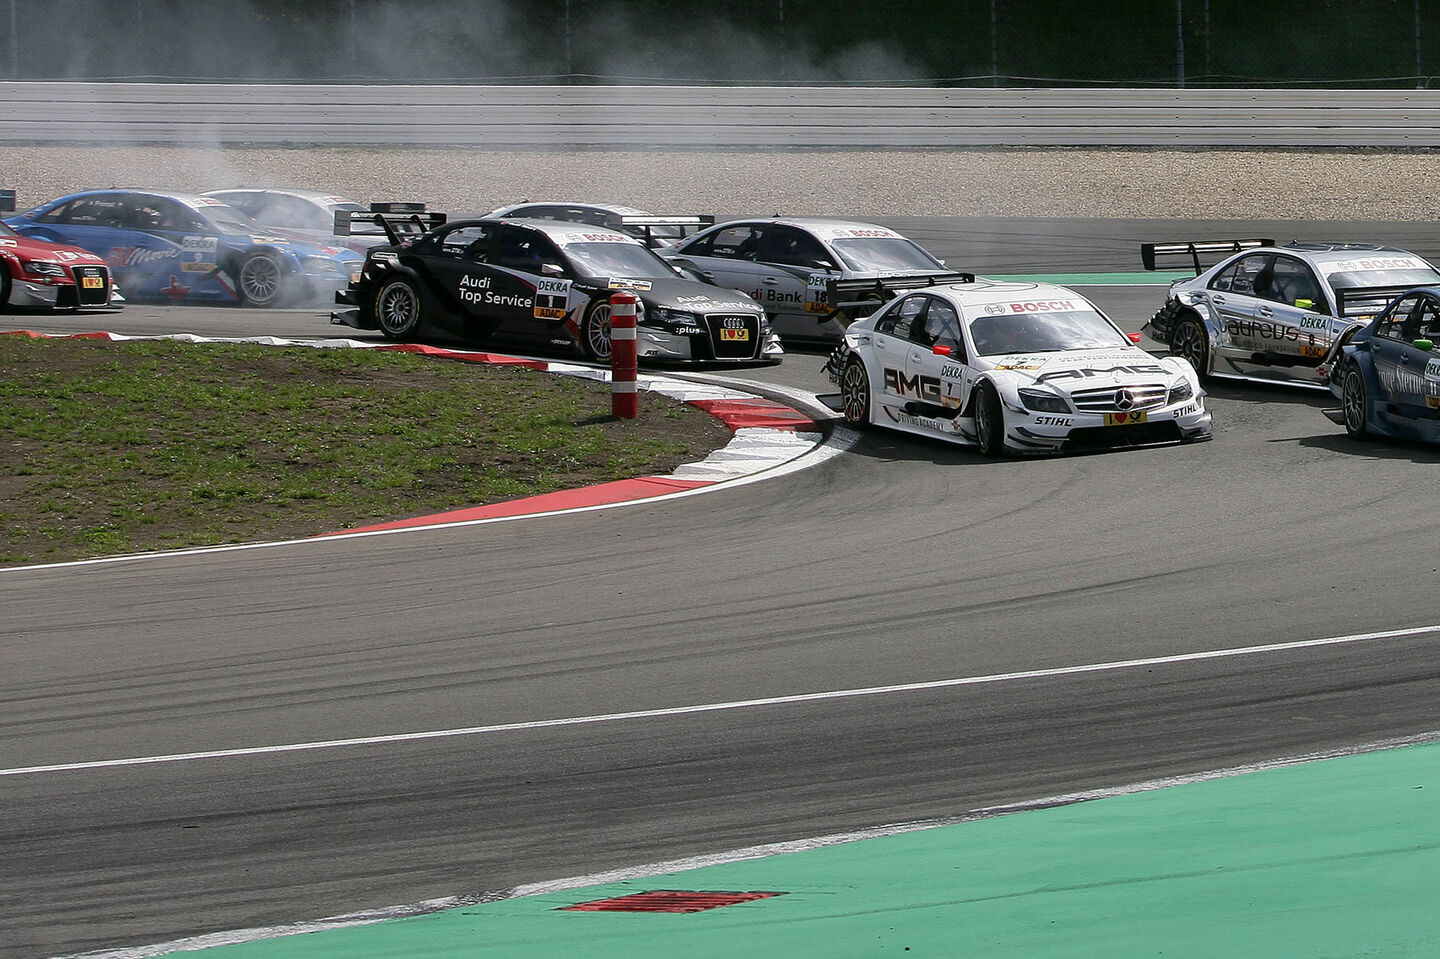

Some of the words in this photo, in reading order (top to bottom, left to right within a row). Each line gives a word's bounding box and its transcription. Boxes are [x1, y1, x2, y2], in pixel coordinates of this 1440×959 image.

[583, 233, 629, 242] BOSCH
[183, 239, 215, 249] DEKRA
[194, 252, 203, 262] 9
[1359, 259, 1416, 269] BOSCH
[460, 274, 491, 290] Audi
[538, 280, 568, 293] DEKRA
[459, 288, 482, 304] Top
[485, 290, 532, 308] Service
[547, 296, 554, 308] 1
[677, 294, 710, 304] Audi
[767, 289, 802, 303] Bank
[814, 291, 827, 302] 18
[686, 301, 711, 311] Top
[1010, 301, 1075, 312] BOSCH
[538, 308, 561, 318] ADAC
[1301, 317, 1327, 330] DEKRA
[1222, 320, 1299, 342] aureus
[1308, 334, 1315, 346] 8
[1305, 346, 1323, 356] ADAC
[942, 364, 963, 380] DEKRA
[1034, 365, 1173, 385] AMG
[884, 368, 941, 403] AMG
[1396, 366, 1427, 395] Sterne
[1173, 405, 1197, 419] STIHL
[1034, 416, 1073, 427] STIHL
